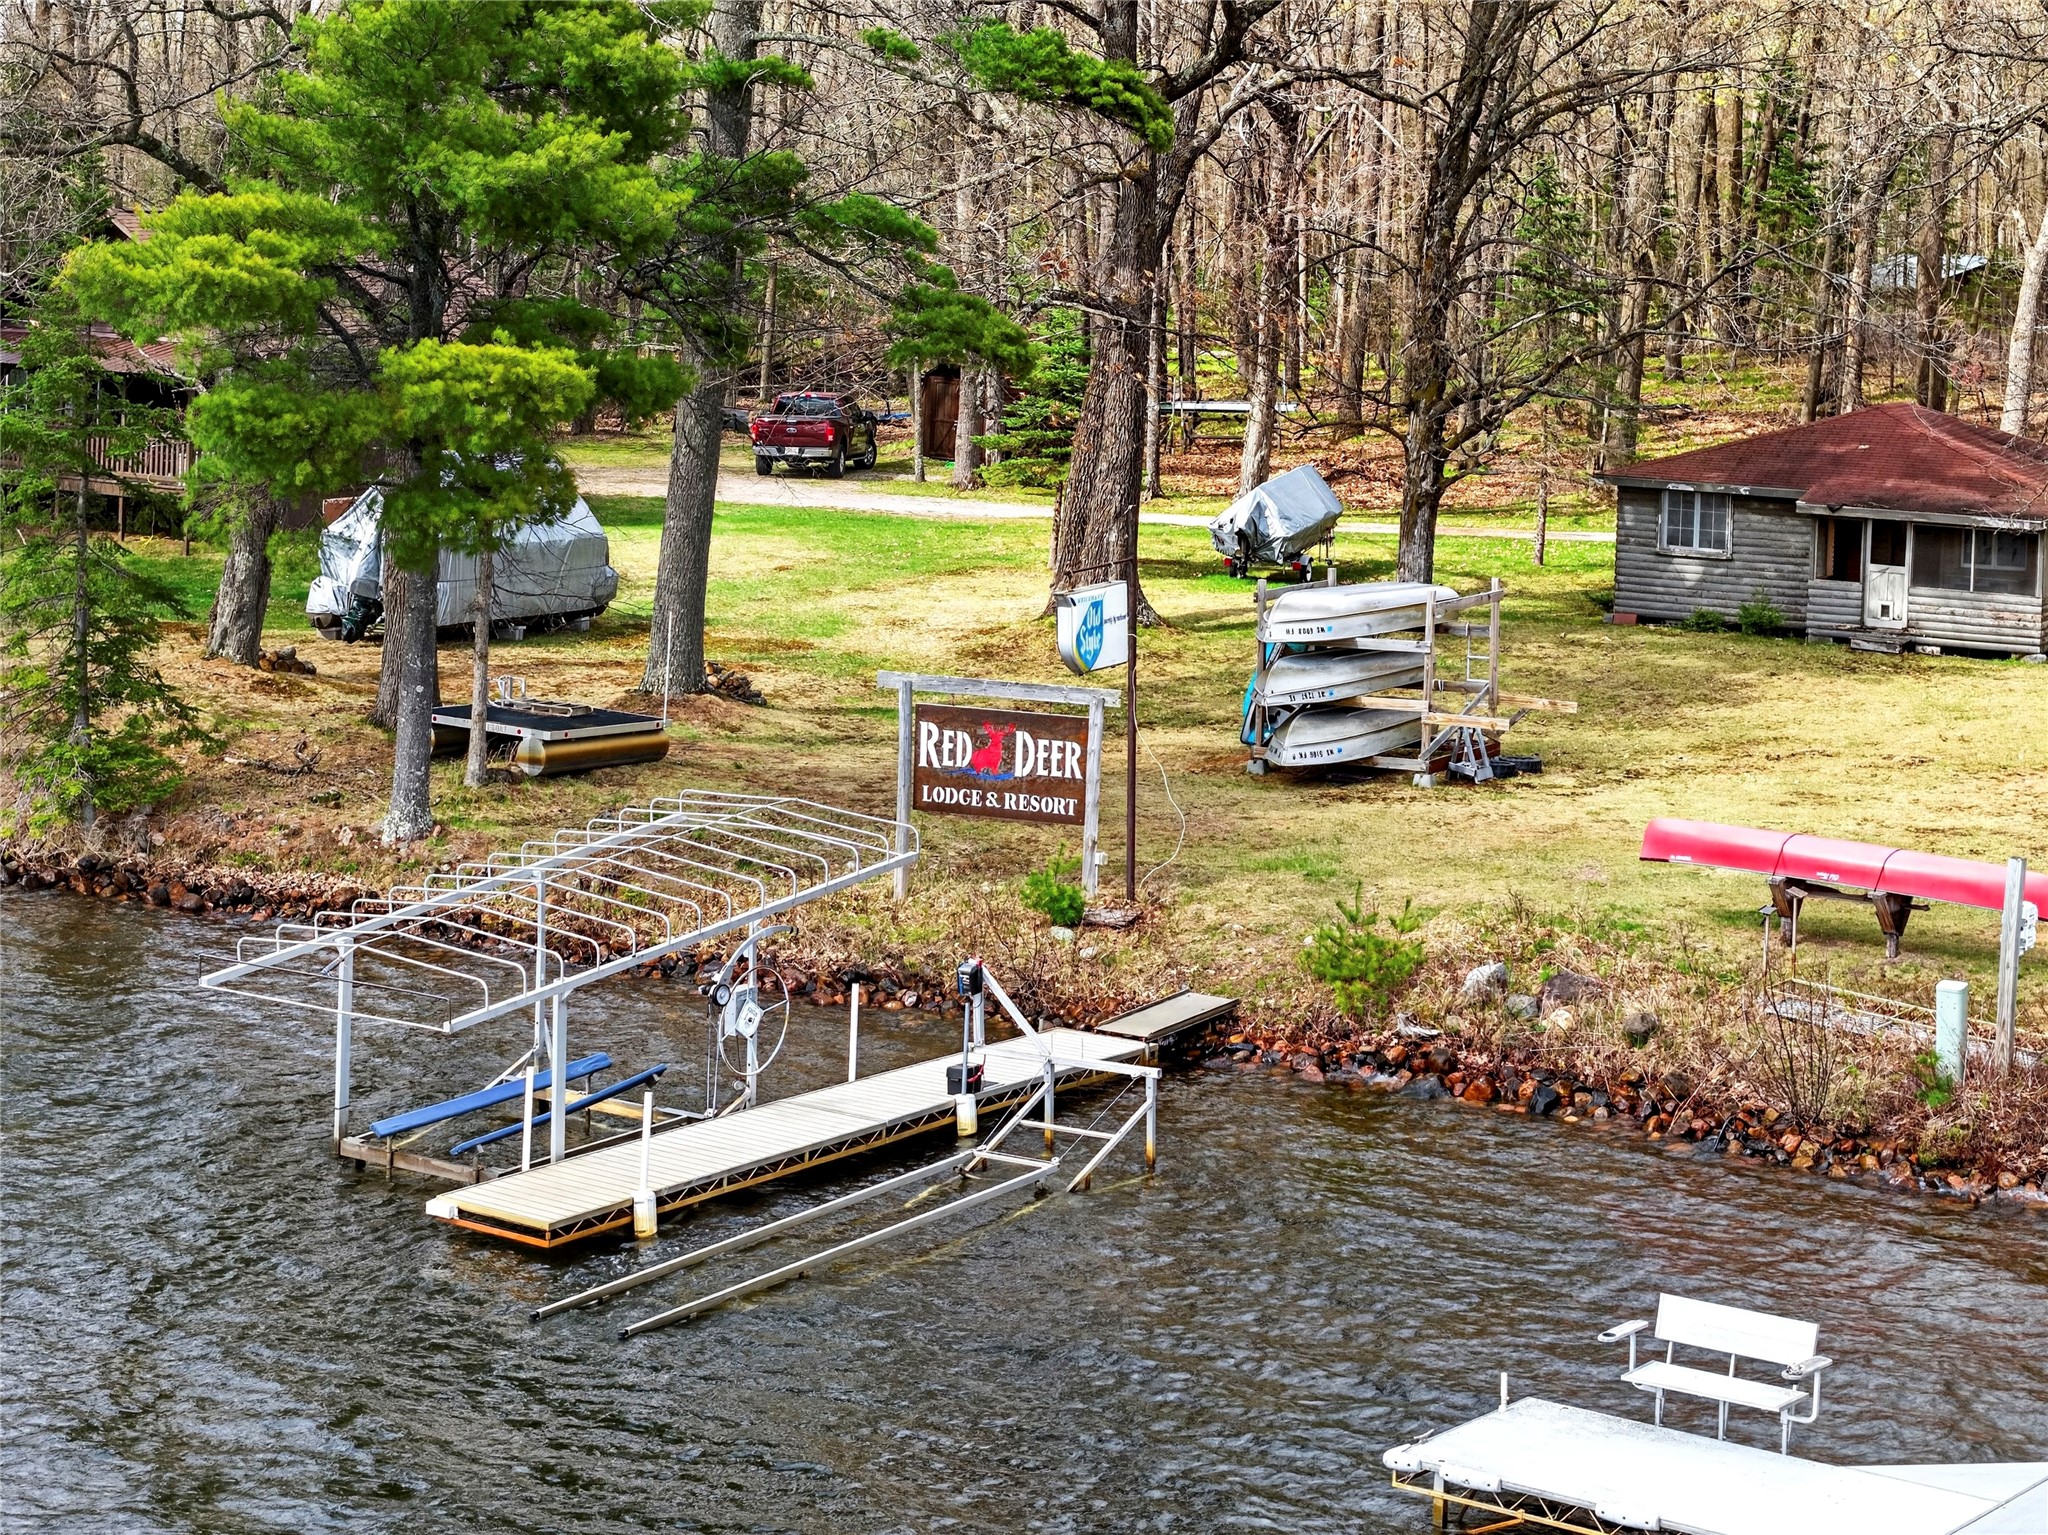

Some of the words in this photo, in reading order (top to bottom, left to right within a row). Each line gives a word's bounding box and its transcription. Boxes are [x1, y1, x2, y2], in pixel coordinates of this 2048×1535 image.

[1087, 605, 1101, 630] Old
[1079, 625, 1102, 661] Style
[918, 720, 973, 769] RED
[1014, 730, 1083, 780] DEER
[921, 784, 982, 807] LODGE
[985, 791, 1001, 808] &
[1003, 792, 1078, 816] RESORT
